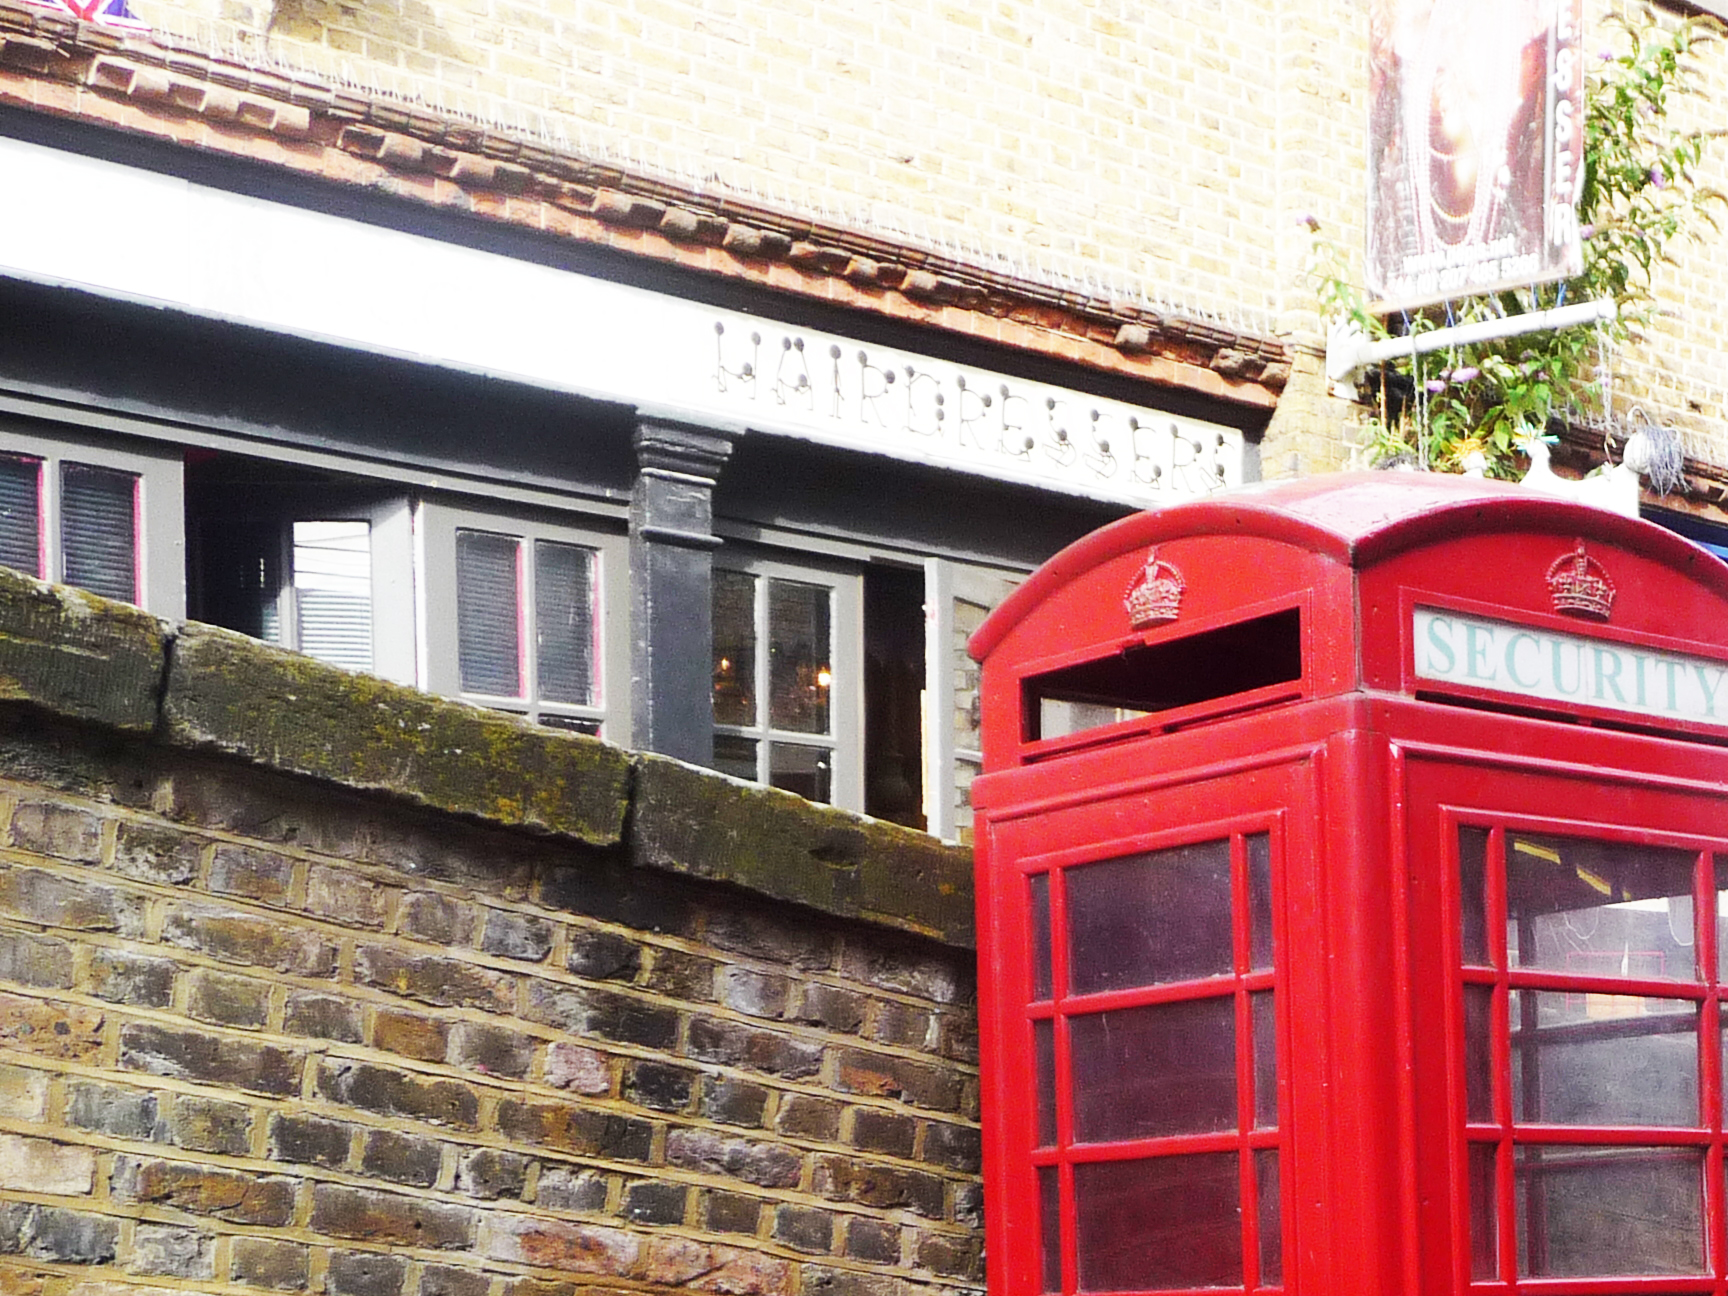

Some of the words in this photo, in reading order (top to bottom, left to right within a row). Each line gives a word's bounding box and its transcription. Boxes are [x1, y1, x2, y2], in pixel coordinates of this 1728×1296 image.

[1440, 267, 1467, 291] 207
[713, 320, 1235, 494] HAIRDRESSERS
[1426, 616, 1726, 718] SECURITY
